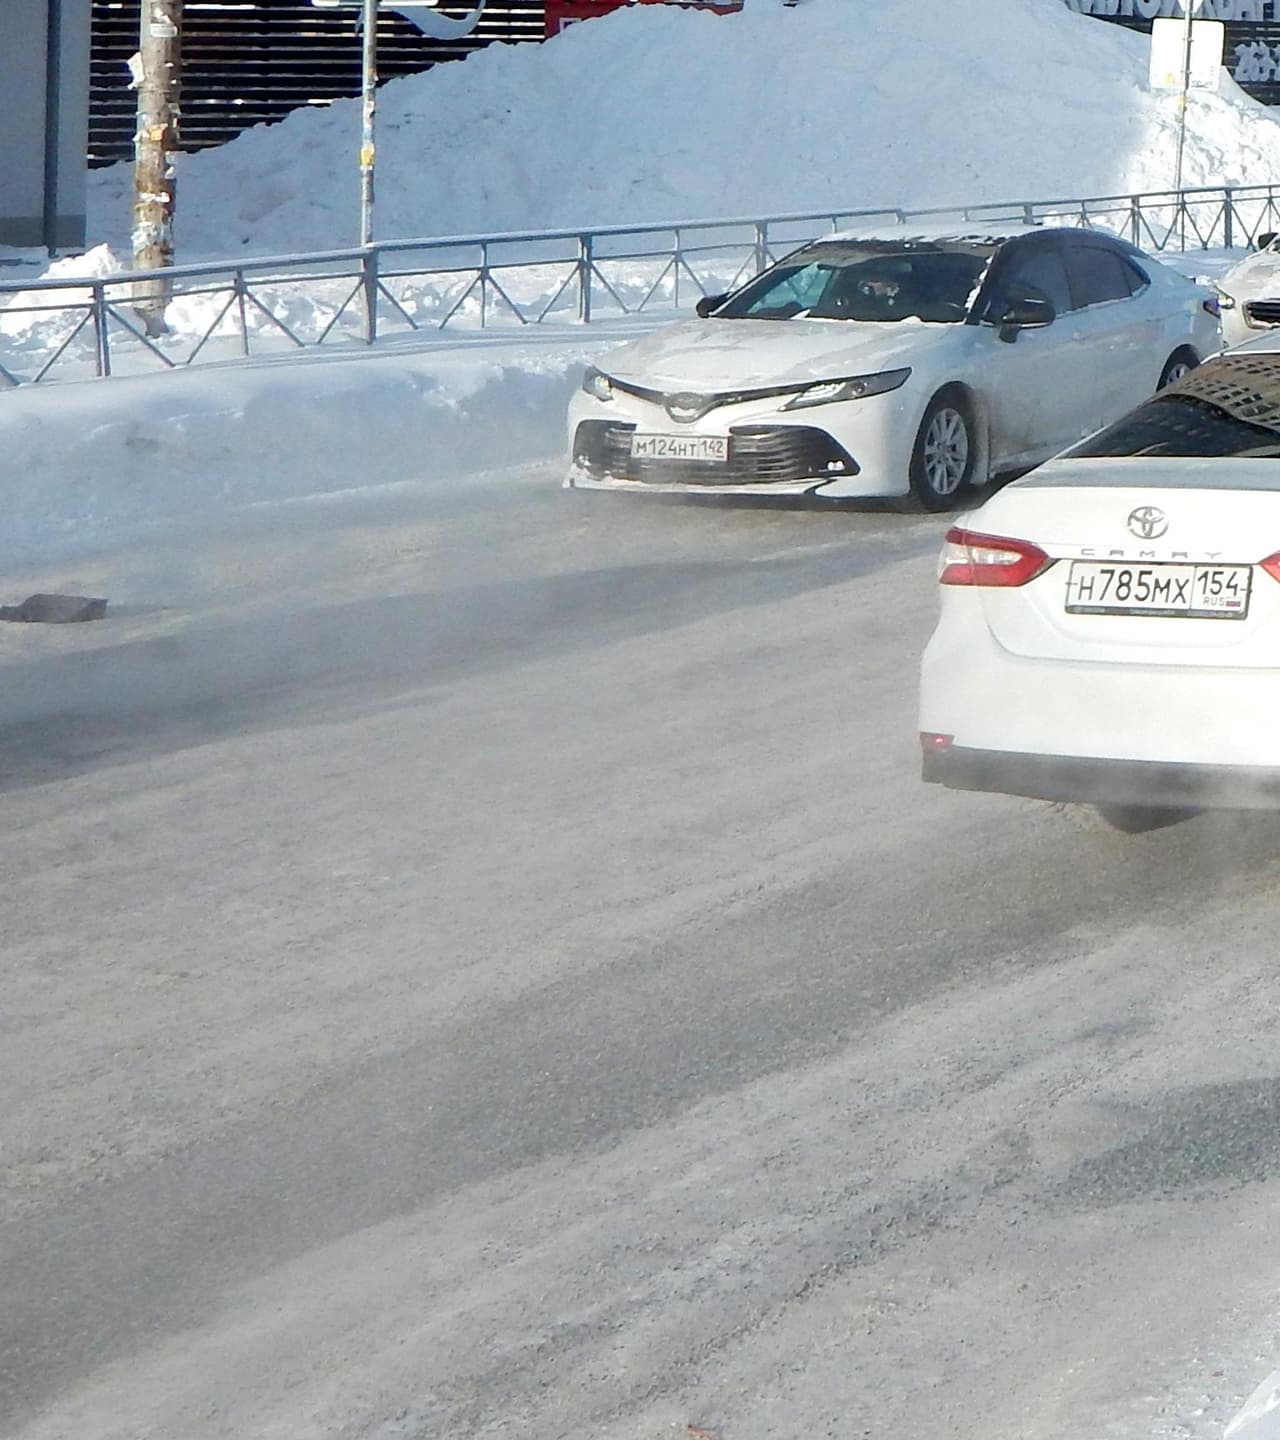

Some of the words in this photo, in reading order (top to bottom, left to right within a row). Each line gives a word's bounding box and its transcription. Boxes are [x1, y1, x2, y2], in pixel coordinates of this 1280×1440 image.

[636, 439, 697, 456] М124НТ
[701, 439, 724, 453] 142
[1081, 548, 1222, 560] CAMRY
[1077, 569, 1190, 604] Н785МХ
[1197, 570, 1239, 597] 154
[1203, 596, 1225, 607] RUS
